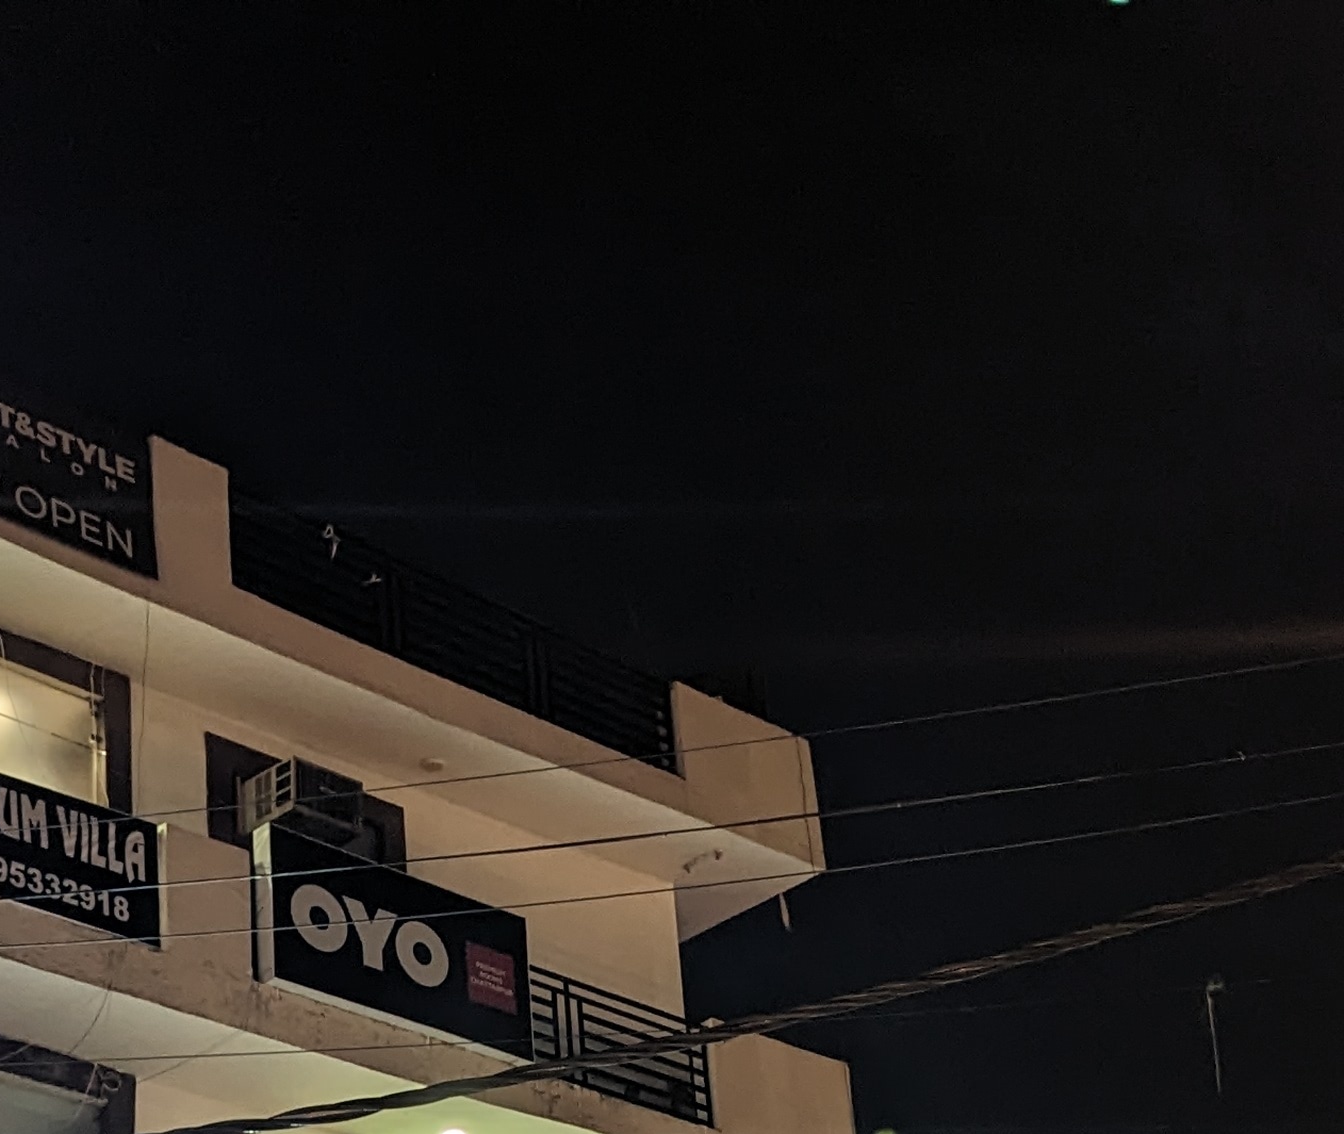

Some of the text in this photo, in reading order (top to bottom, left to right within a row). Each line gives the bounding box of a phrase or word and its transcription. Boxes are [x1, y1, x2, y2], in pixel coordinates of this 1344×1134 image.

[14, 485, 134, 559] OPEN
[55, 804, 147, 884] VILLA
[290, 883, 450, 988] OYO
